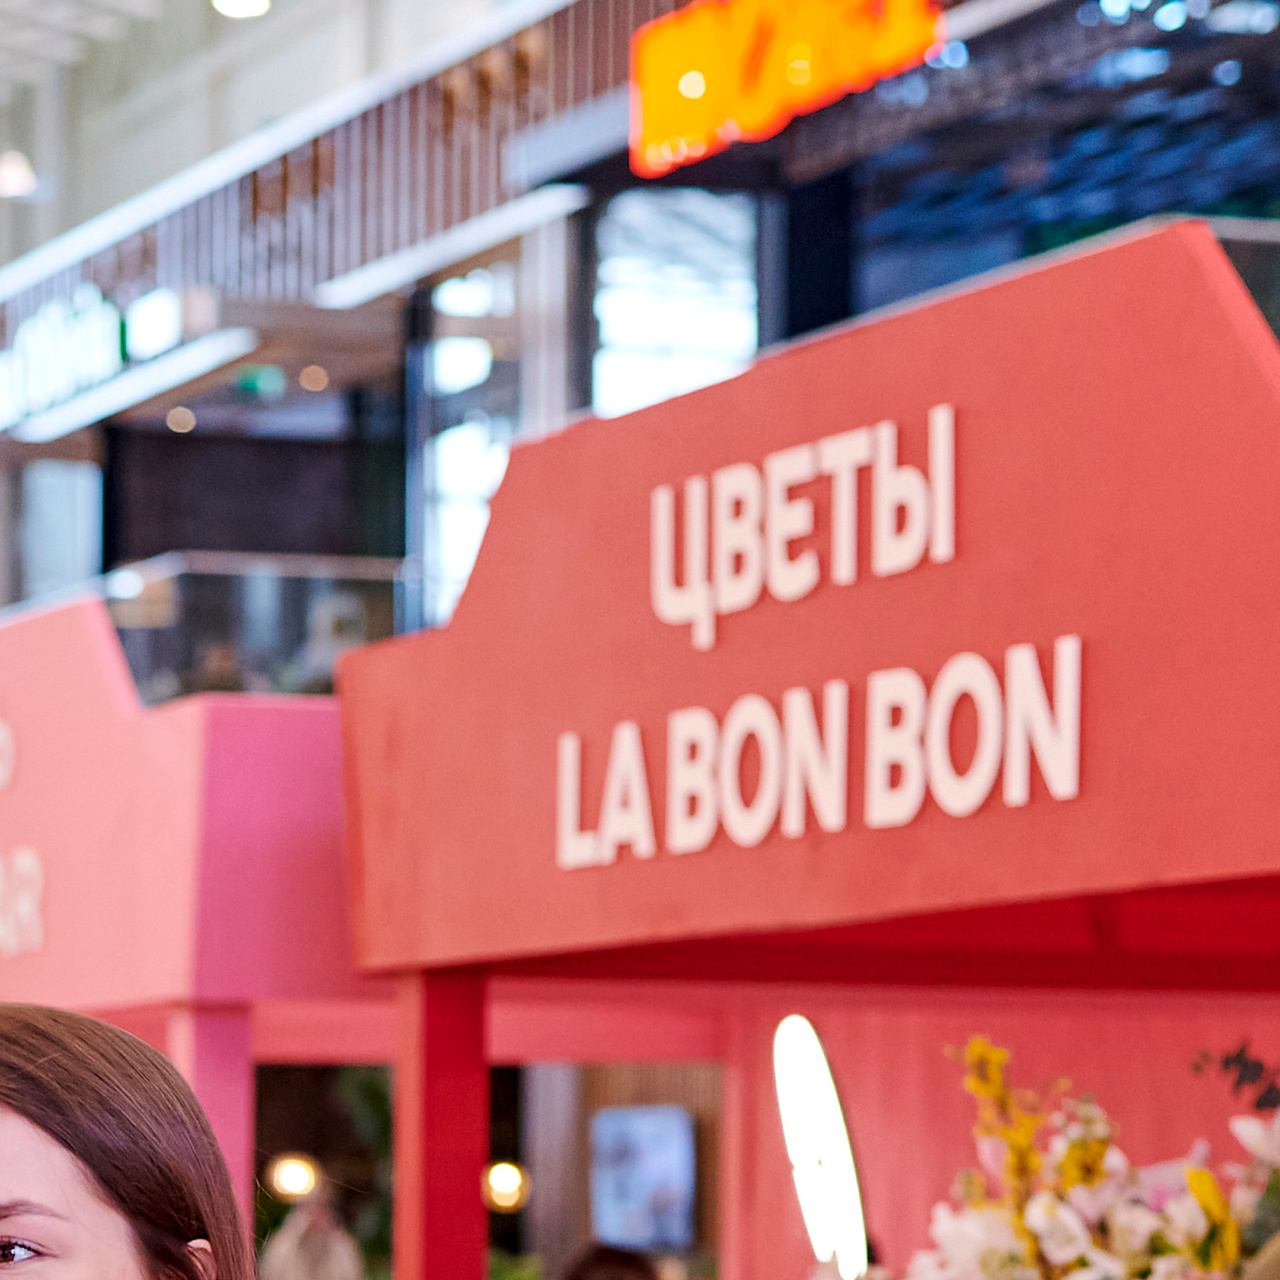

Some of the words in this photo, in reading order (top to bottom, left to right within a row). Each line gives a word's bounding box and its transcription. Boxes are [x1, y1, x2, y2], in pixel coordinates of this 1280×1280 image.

[650, 402, 956, 652] ЦВЕТЫ
[556, 720, 656, 870] LA
[666, 678, 849, 849] BON
[864, 633, 1083, 830] BON
